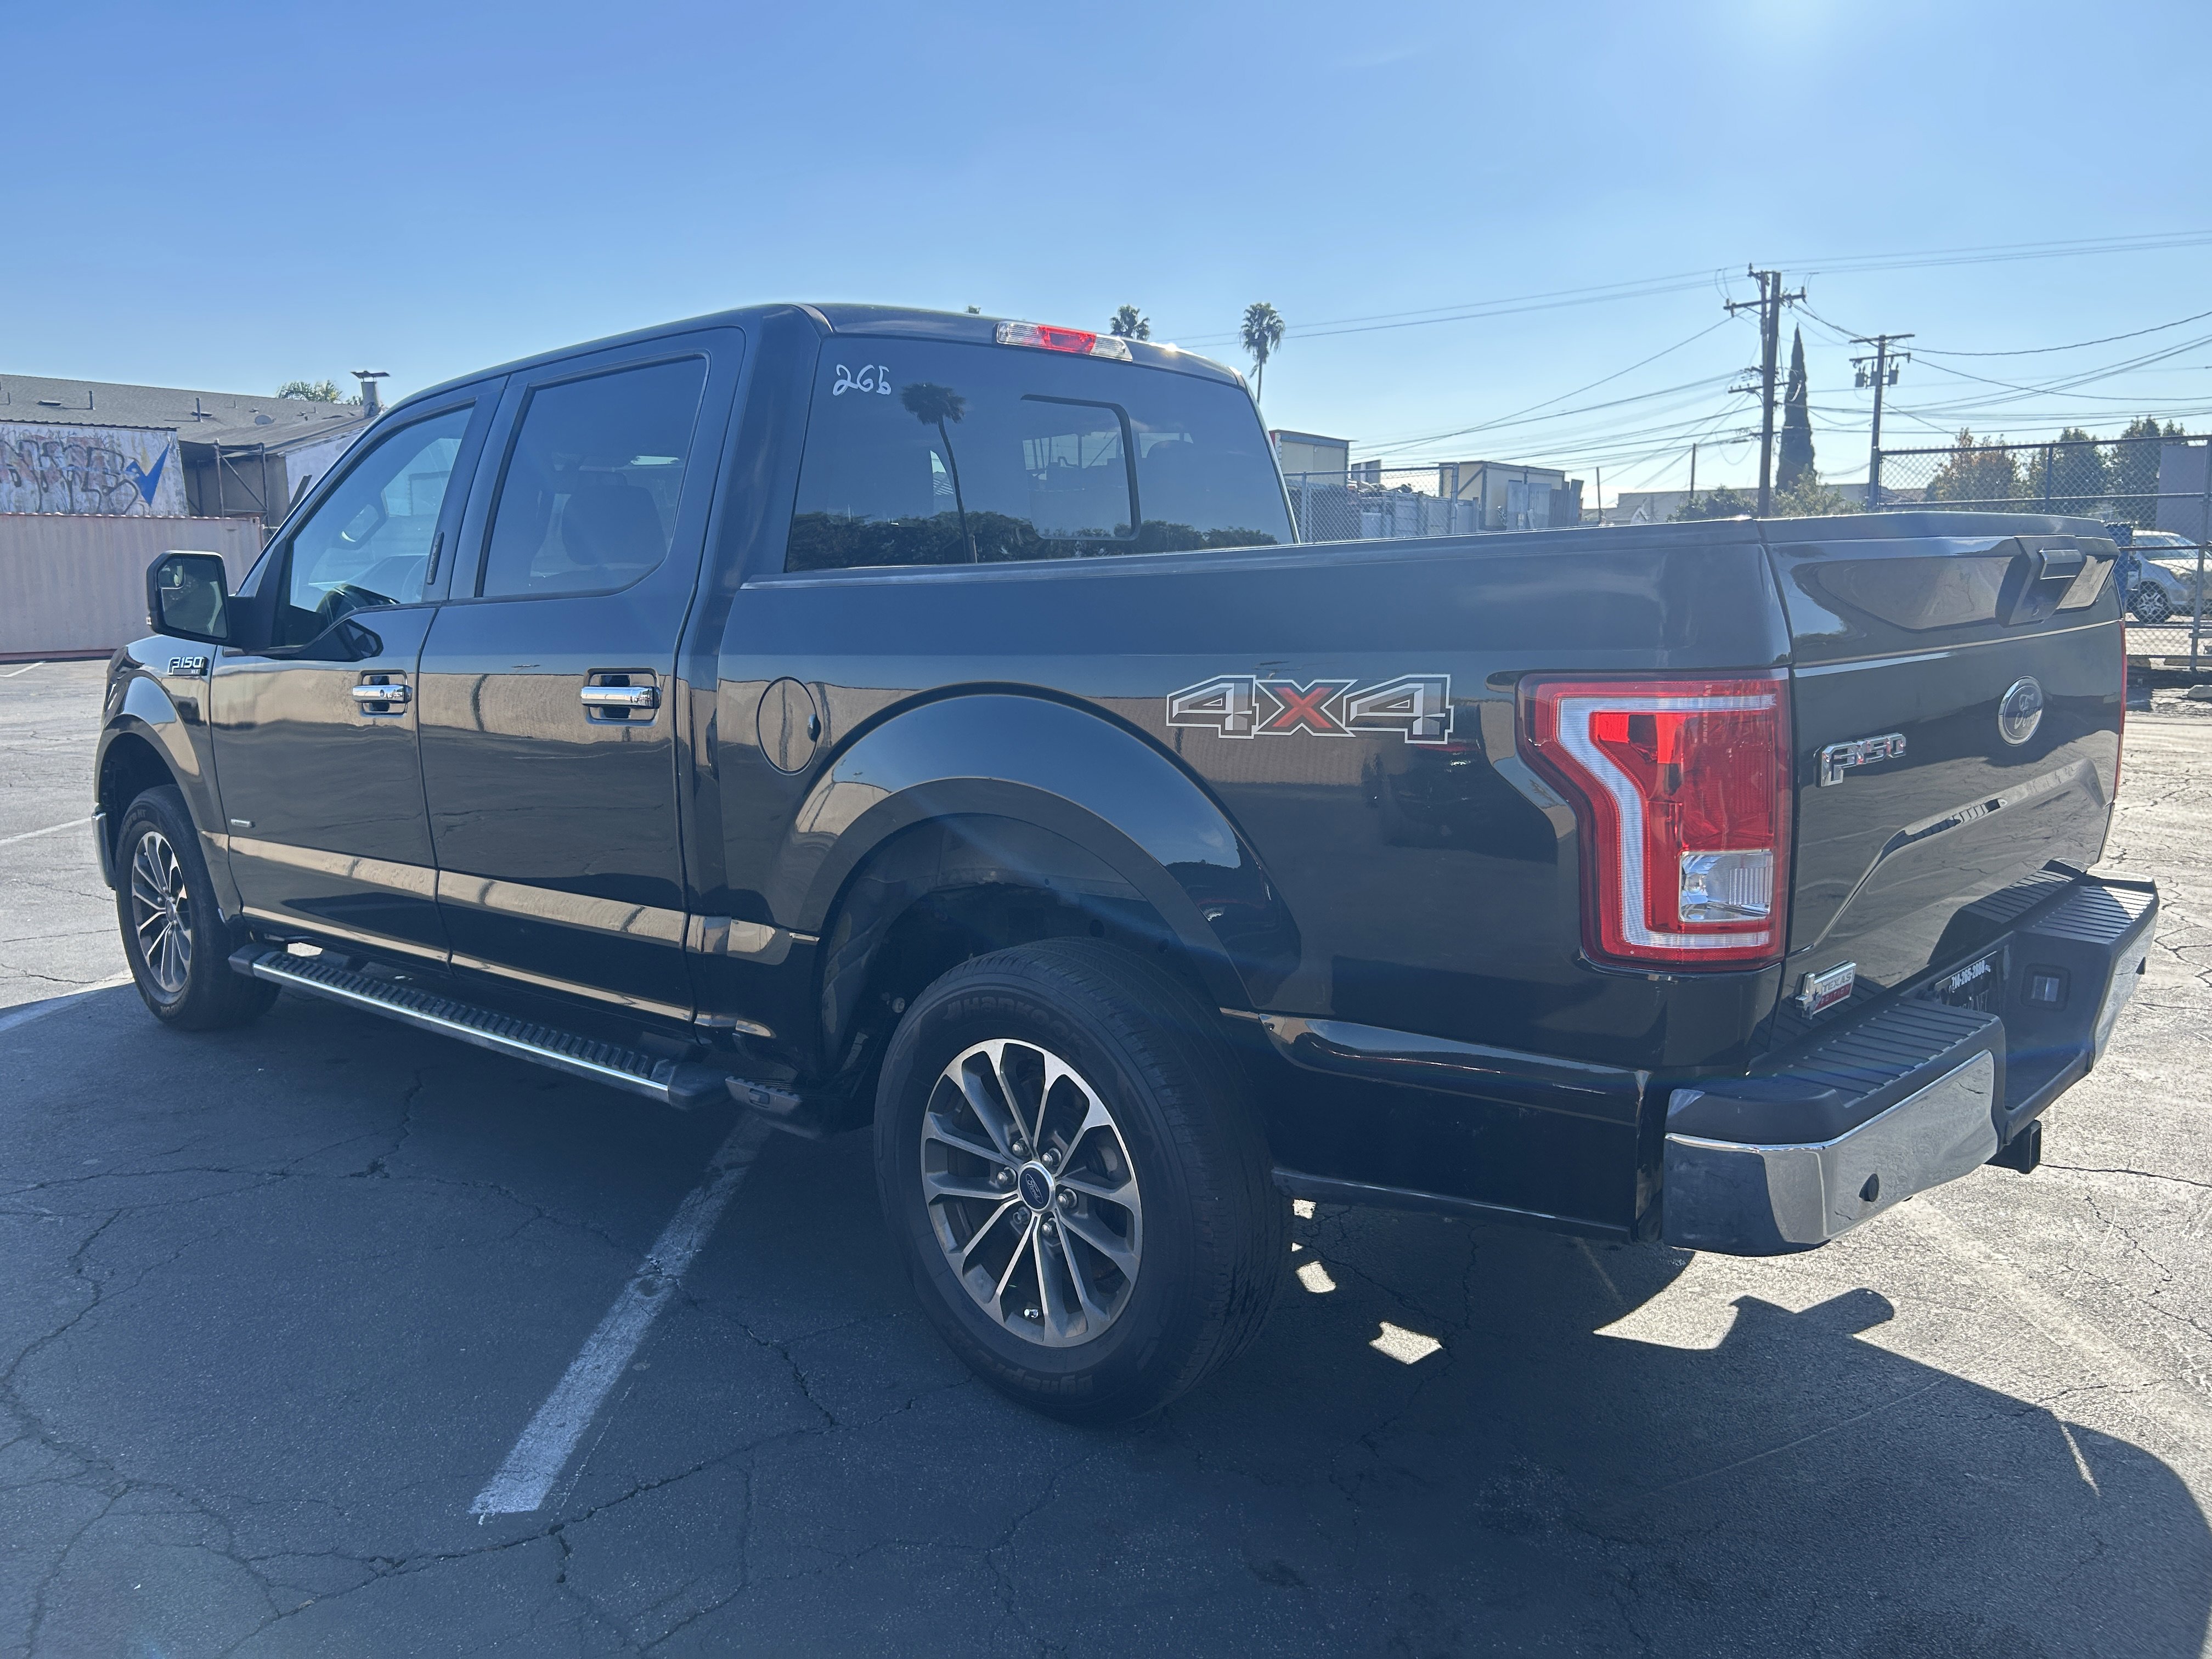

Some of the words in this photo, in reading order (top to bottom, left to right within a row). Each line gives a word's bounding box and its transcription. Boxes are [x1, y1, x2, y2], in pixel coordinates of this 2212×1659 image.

[2014, 693, 2039, 730] Ford
[1822, 972, 1853, 992] TEXAS
[1821, 986, 1849, 1005] EDITION
[1026, 1180, 1041, 1200] Ford
